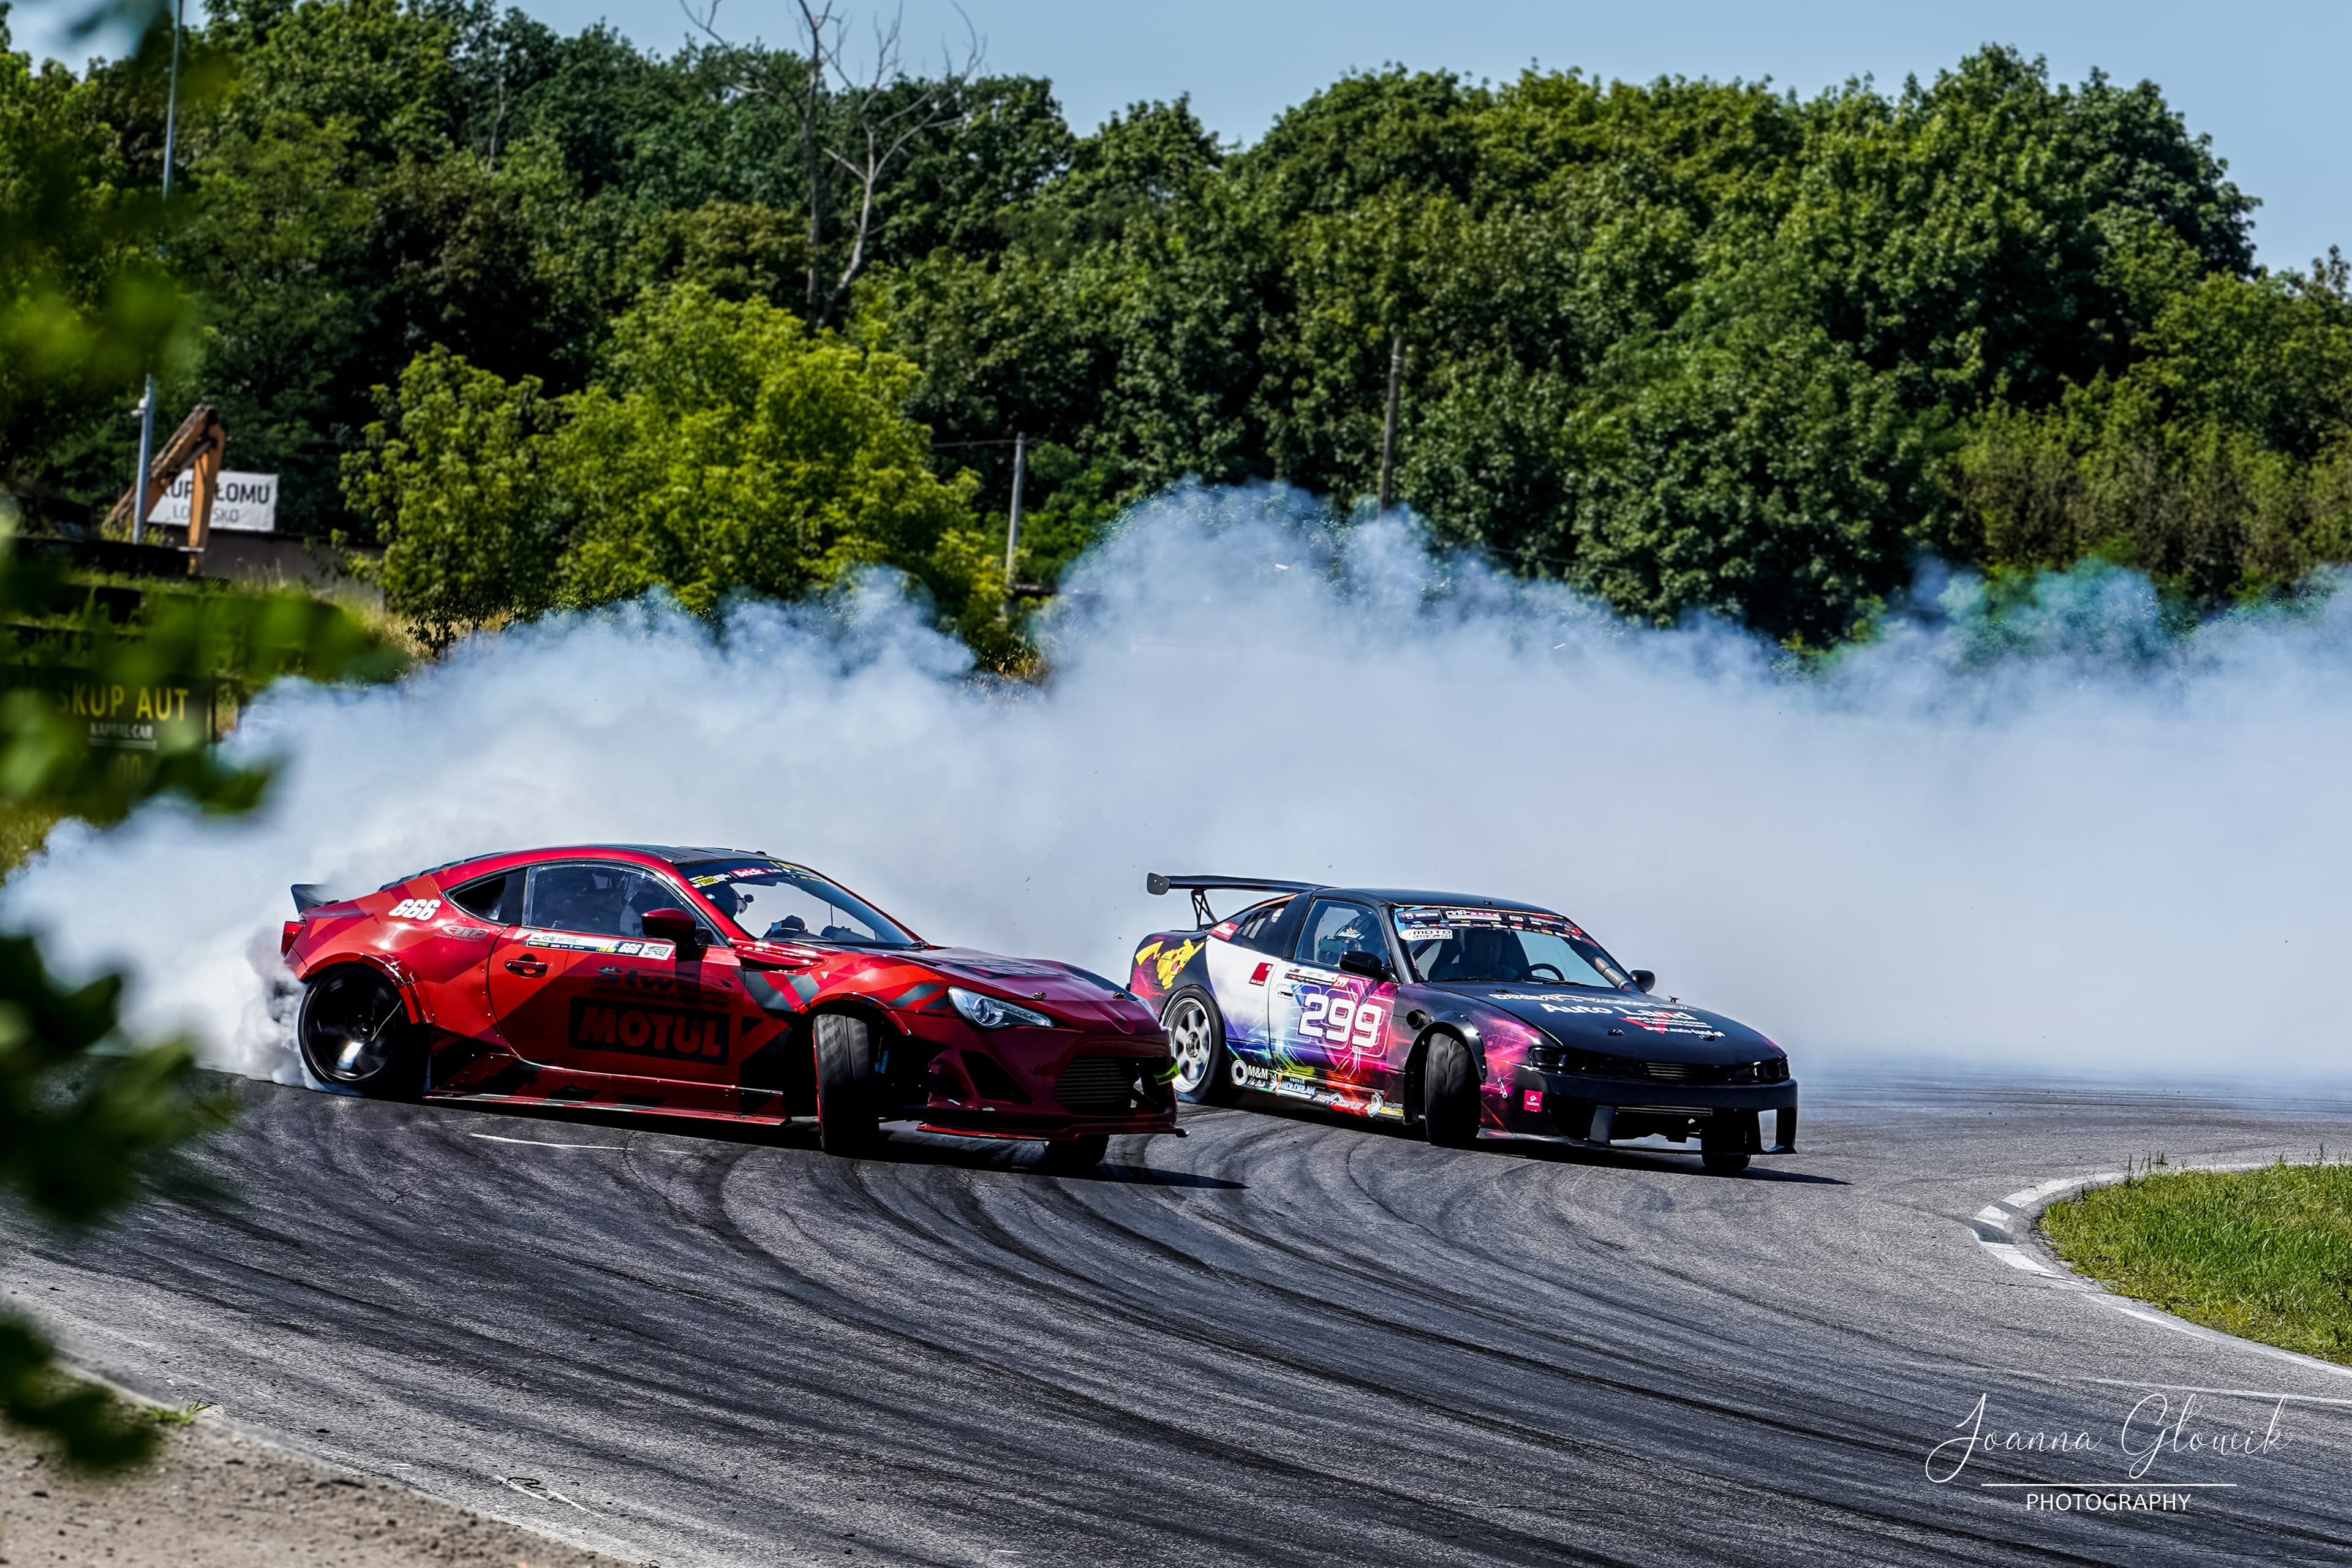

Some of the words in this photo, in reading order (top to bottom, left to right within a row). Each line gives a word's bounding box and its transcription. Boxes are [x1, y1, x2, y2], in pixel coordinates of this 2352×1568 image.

[135, 687, 189, 721] AUT
[388, 899, 441, 921] 666
[618, 943, 642, 954] 666
[1333, 975, 1351, 988] 299
[1298, 993, 1382, 1048] 299
[1540, 1003, 1613, 1014] Auto
[1613, 1006, 1698, 1020] Land
[578, 1006, 722, 1057] MOTUL
[1248, 1065, 1268, 1080] M&M
